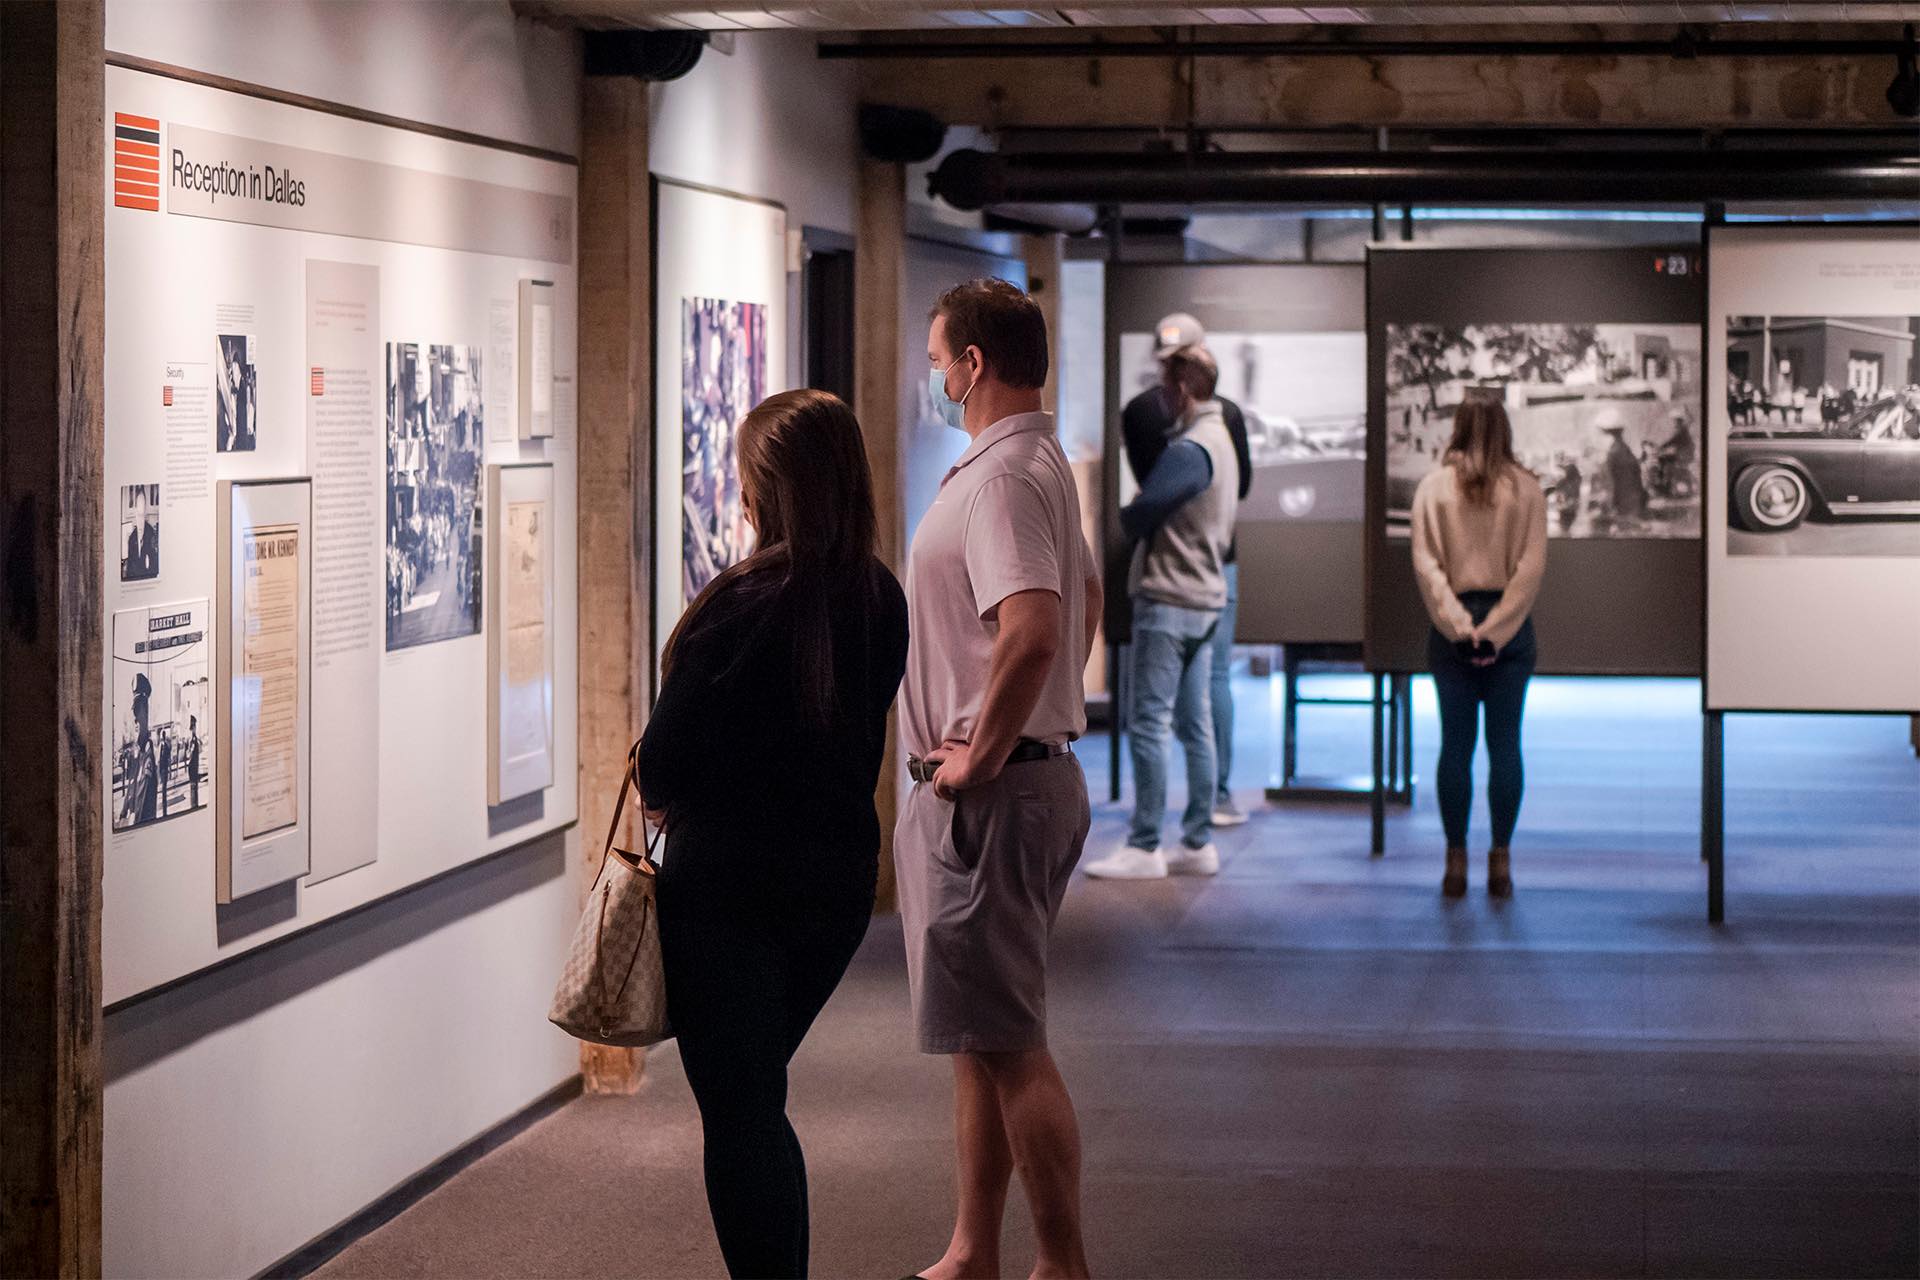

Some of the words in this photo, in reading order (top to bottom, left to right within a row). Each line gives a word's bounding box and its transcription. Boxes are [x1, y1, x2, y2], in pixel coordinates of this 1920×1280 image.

[172, 149, 246, 203] Reception
[249, 165, 261, 199] in
[265, 165, 305, 206] Dallas
[166, 366, 184, 380] Security
[150, 618, 173, 630] MARKET
[175, 613, 189, 625] HALL
